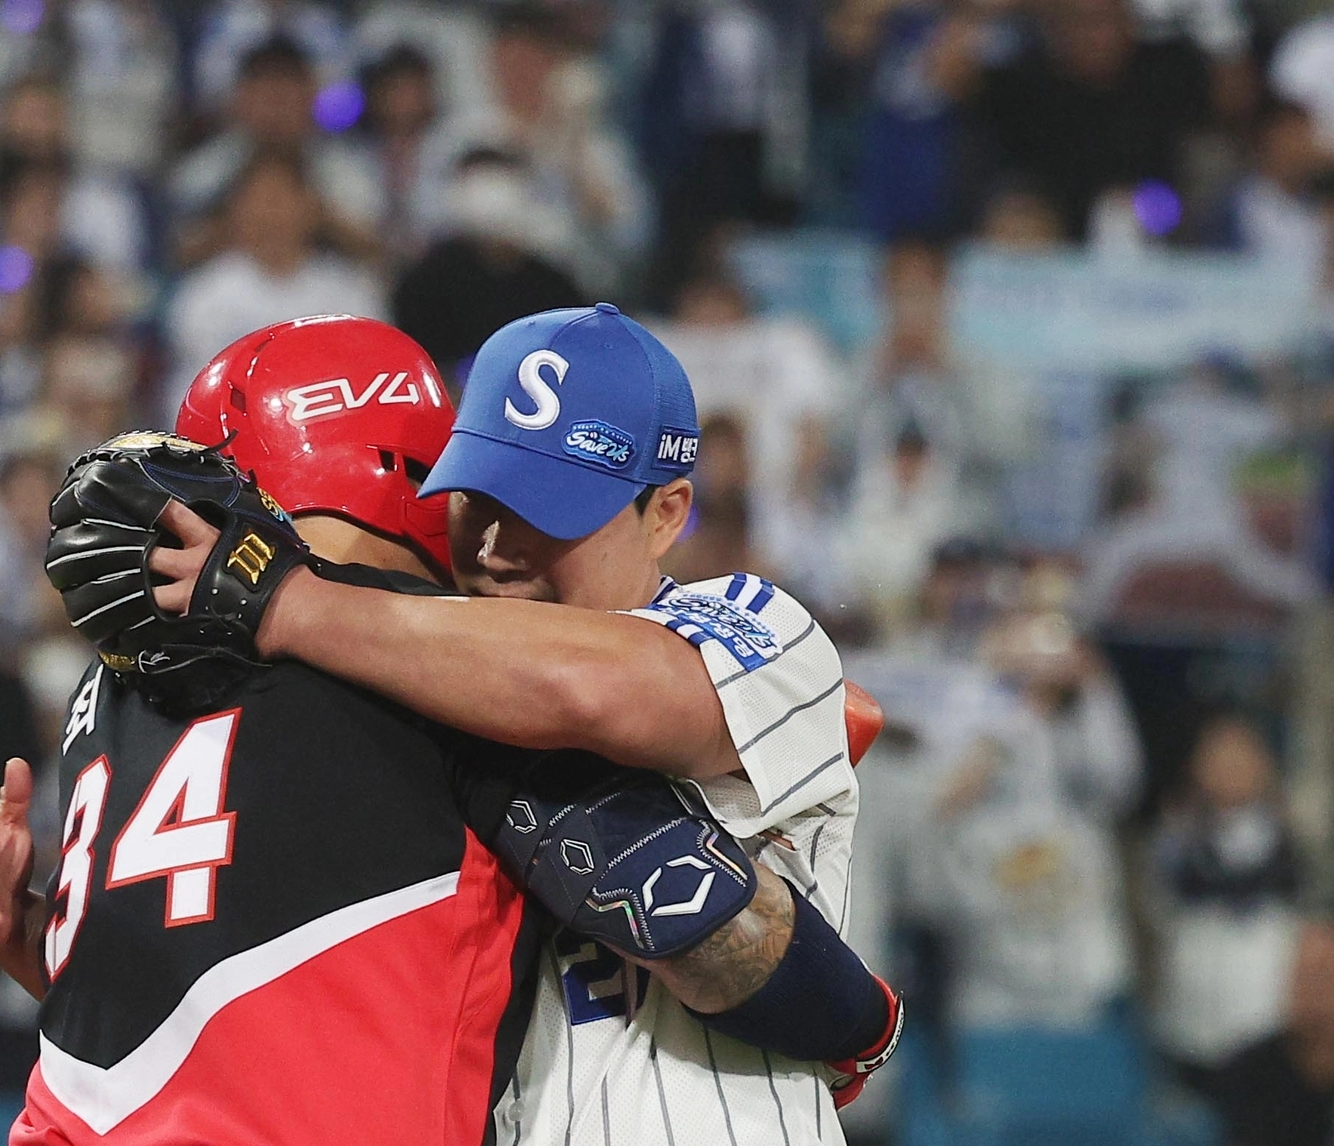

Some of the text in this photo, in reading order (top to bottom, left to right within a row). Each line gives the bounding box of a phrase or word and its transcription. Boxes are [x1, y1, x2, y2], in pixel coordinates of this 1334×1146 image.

[286, 371, 420, 421] EV4
[504, 350, 570, 430] S
[44, 706, 244, 981] 34
